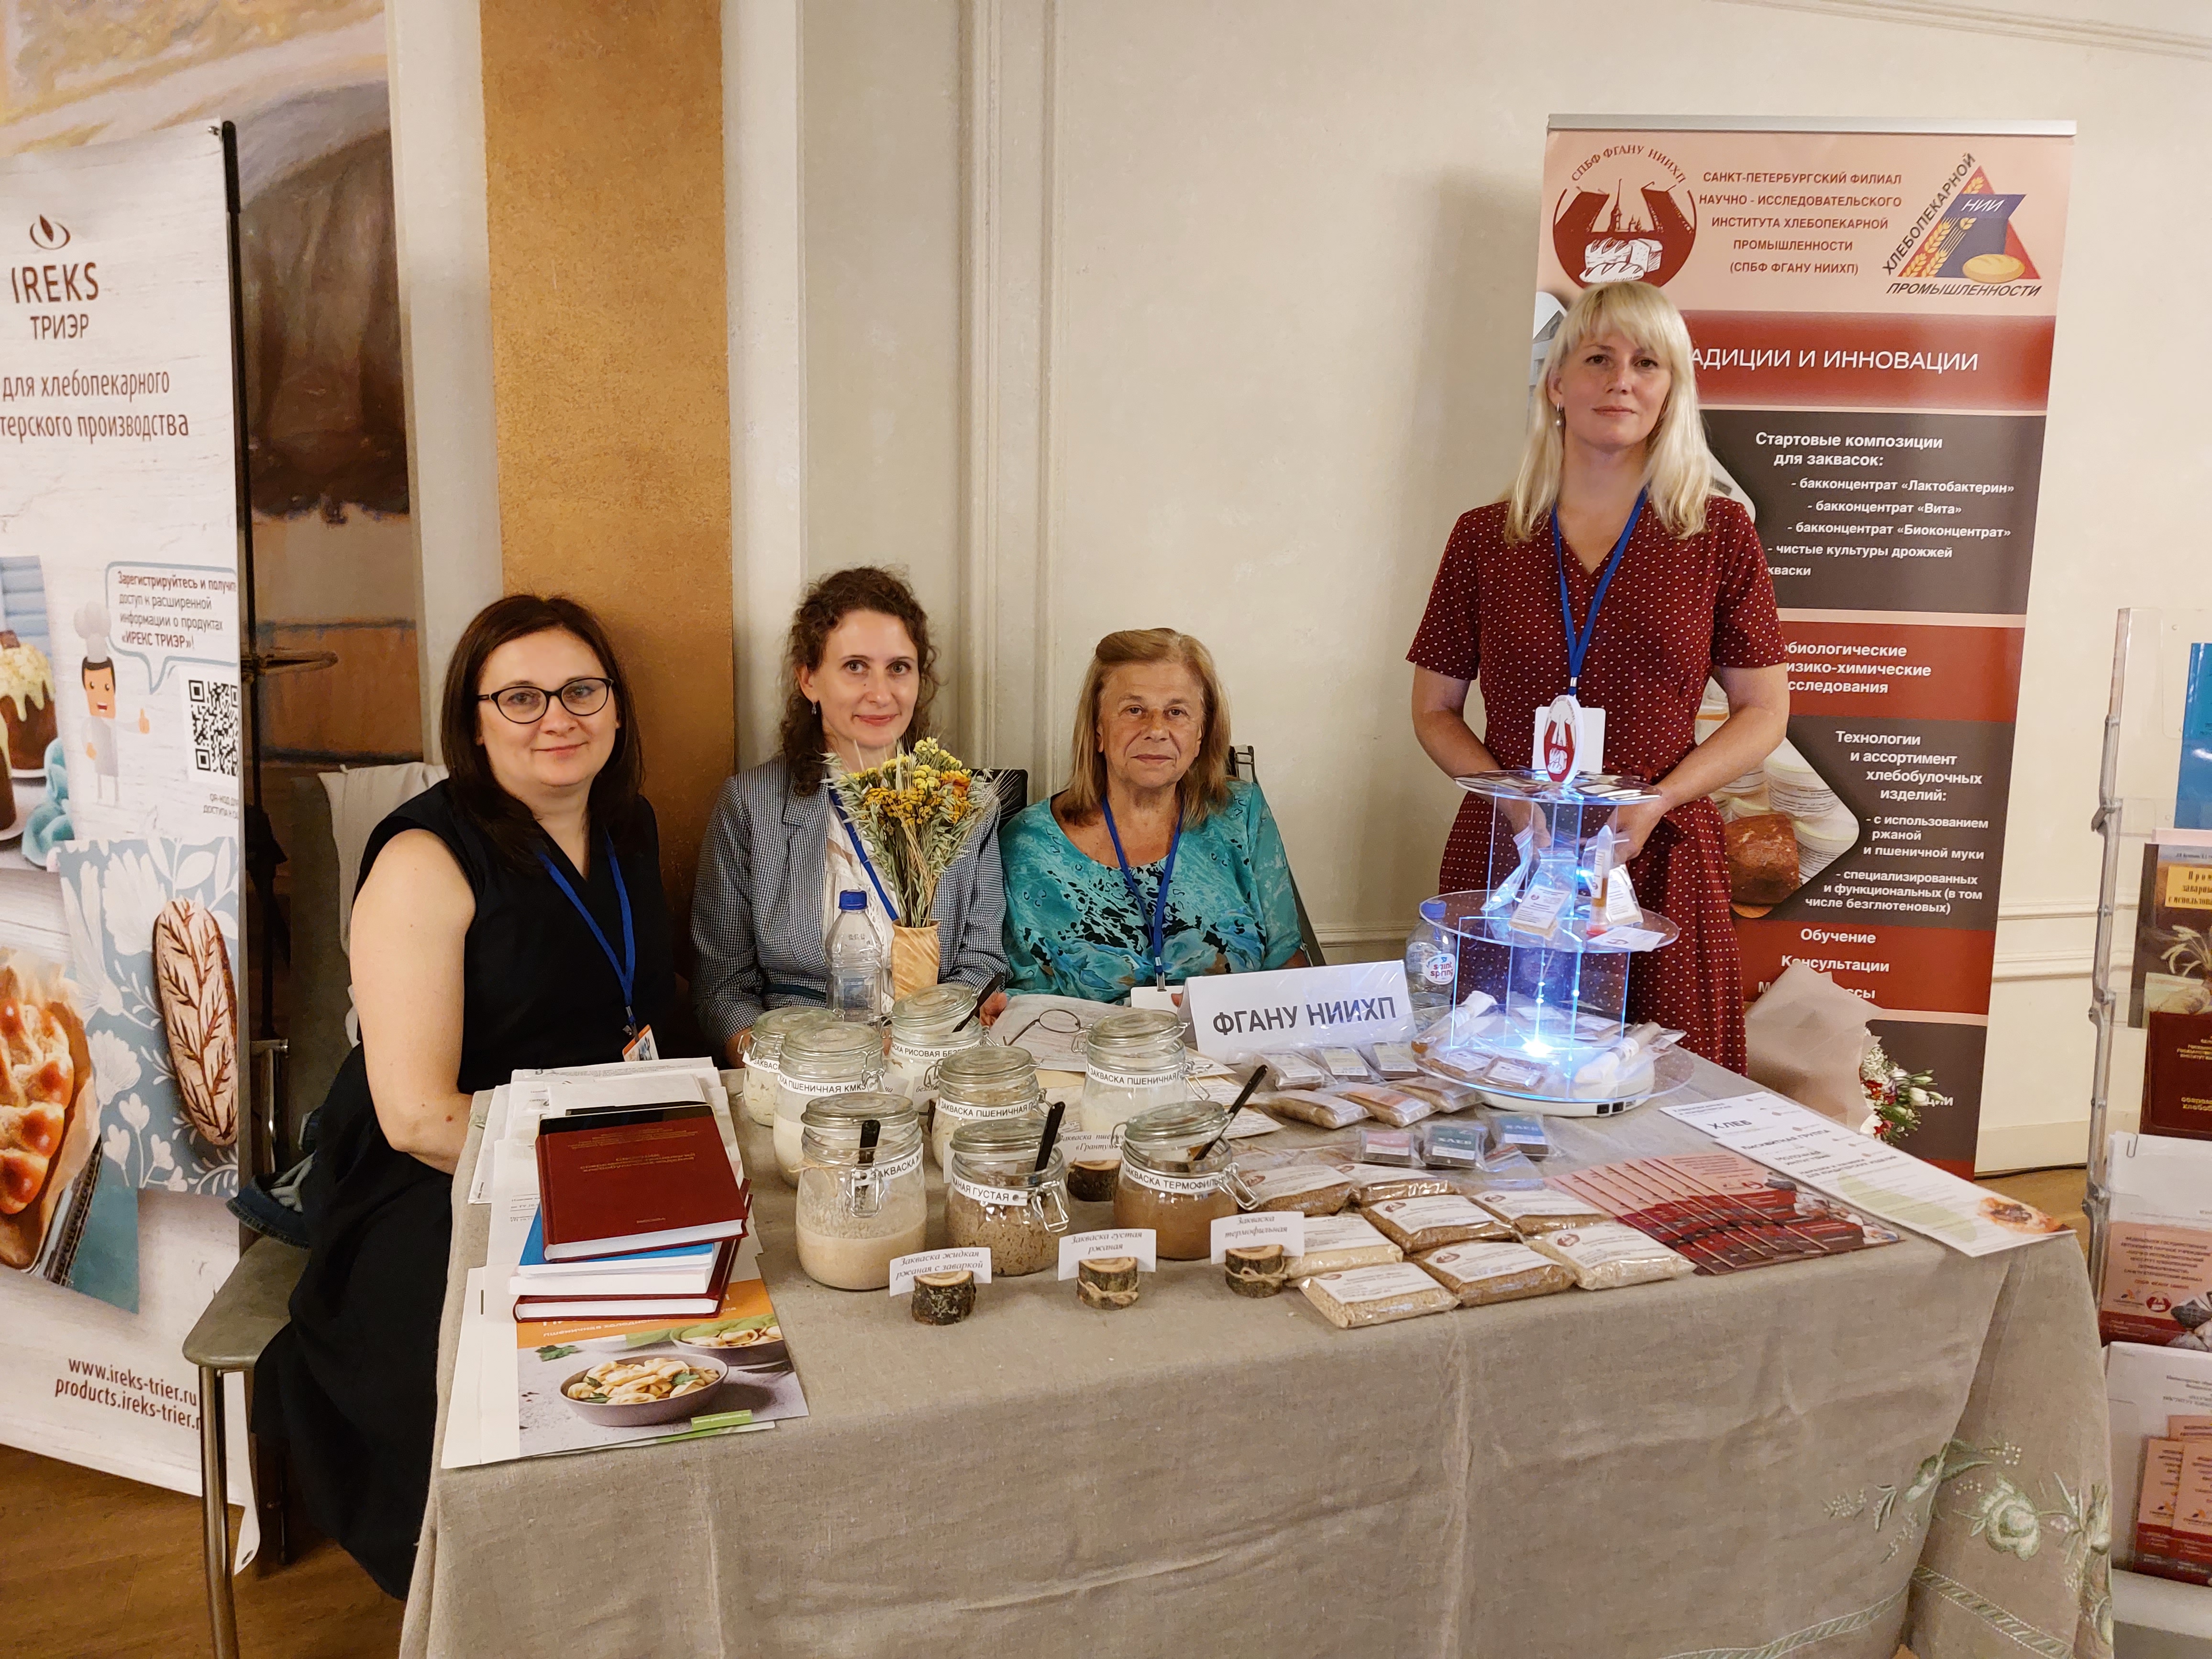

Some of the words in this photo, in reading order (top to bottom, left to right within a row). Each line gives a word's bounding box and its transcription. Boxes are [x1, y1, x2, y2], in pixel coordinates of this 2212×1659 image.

[1571, 154, 1601, 182] СПБФ
[1604, 145, 1644, 159] ФГАНУ
[1648, 148, 1687, 184] НИИХП
[1703, 171, 1847, 184] САНКТ-ПЕТЕРБУРГСКИЙ
[1850, 174, 1902, 185] ФИЛИАЛ
[1699, 195, 1747, 205] НАУЧНО
[1758, 195, 1902, 207] ИССЛЕДОВАТЕЛЬСКОГО
[1961, 199, 2004, 212] НИИ
[1882, 153, 1976, 276] ХЛЕБОПЕКАРНОЙ
[1712, 217, 1780, 228] ИНСТИТУТА
[1783, 218, 1888, 230] ХЛЕБОПЕКАРНОЙ
[1734, 240, 1853, 252] ПРОМЫШЛЕННОСТИ
[1730, 262, 1767, 275] (СПБФ
[1771, 263, 1811, 274] ФГАНУ
[1814, 263, 1858, 276] НИИХП)
[11, 263, 99, 303] IREKS
[1886, 283, 2042, 297] ПРОМЫШЛЕННОСТИ
[31, 314, 89, 340] ТРИЭР
[1691, 348, 1790, 371] АДИЦИИ
[1799, 350, 1815, 367] И
[1823, 351, 1979, 374] ИННОВАЦИИ
[3, 376, 34, 402] для
[41, 369, 169, 402] хлебопекарного
[0, 415, 72, 442] терского
[78, 414, 188, 444] производства
[1756, 432, 1841, 449] Стартовые
[1845, 435, 1943, 450] композиции
[1774, 453, 1802, 467] для
[1807, 454, 1884, 467] заквасок:
[1800, 478, 1898, 492] бакконцентрат
[1901, 480, 2014, 495] «Лактобактерин»
[1816, 500, 1914, 515] бакконцентрат
[1917, 503, 1962, 515] «Вита»
[1796, 522, 1894, 536] бакконцентрат
[1897, 525, 2011, 538] «Биоконцентрат»
[1776, 544, 1824, 555] чистые
[1826, 546, 1889, 559] культуры
[1891, 547, 1953, 559] дрожжей
[1768, 566, 1811, 576] кваски
[118, 571, 198, 591] Зарегистрируйтесь
[200, 579, 206, 589] и
[119, 594, 142, 608] доступ
[145, 596, 150, 605] к
[153, 597, 211, 611] расширенной
[120, 611, 170, 628] информации
[174, 618, 178, 627] о
[181, 618, 223, 632] продуктах
[122, 630, 153, 646] «ИРЕКС
[1786, 663, 1932, 676] изико-химические
[1788, 681, 1889, 694] сследования
[1836, 731, 1921, 745] Технологии
[1850, 752, 1860, 761] и
[1863, 751, 1958, 766] ассортимент
[1866, 769, 1983, 785] хлебобулочных
[1880, 788, 1947, 802] изделий:
[1874, 816, 1881, 824] с
[1884, 816, 1989, 829] использованием
[1871, 830, 1922, 842] ржаной
[1863, 847, 1871, 855] и
[1875, 846, 1948, 859] пшеничной
[1951, 849, 1985, 862] муки
[1843, 870, 1979, 885] специализированных
[1824, 884, 1832, 893] и
[1834, 884, 1942, 899] функциональных
[1944, 888, 1956, 901] (в
[1958, 891, 1983, 900] том
[1805, 898, 1843, 908] числе
[1846, 898, 1951, 915] безглютеновых)
[1800, 929, 1877, 944] Обучение
[1213, 1006, 1297, 1036] ФГАНУ
[1306, 996, 1396, 1026] НИИХП
[905, 1048, 940, 1057] РИСОВАЯ
[753, 1060, 780, 1070] ЗАКВАС
[1090, 1068, 1125, 1084] ЗАКВАСКА
[1127, 1073, 1176, 1084] ПШЕНИЧНАЯ
[788, 1080, 841, 1093] ПШЕНИЧНАЯ
[941, 1101, 973, 1117] ЗАКВАСКА
[976, 1104, 1028, 1117] ПШЕНИЧНАЯ
[1706, 1120, 1752, 1129] ХЛЕБ
[1126, 1164, 1161, 1187] ЗАКВАСКА
[973, 1187, 1009, 1201] ГУСТАЯ
[1238, 1217, 1274, 1225] Закваска
[1071, 1233, 1109, 1244] Закваска
[1111, 1232, 1142, 1240] густая
[1088, 1244, 1123, 1254] ржаная
[901, 1252, 940, 1266] Закваска
[942, 1250, 979, 1259] жидкая
[896, 1266, 931, 1281] ржаная
[942, 1261, 983, 1271] заваркой
[68, 1358, 197, 1406] www.ireks-trier.ru
[55, 1378, 200, 1430] products.ireks-trier.r
